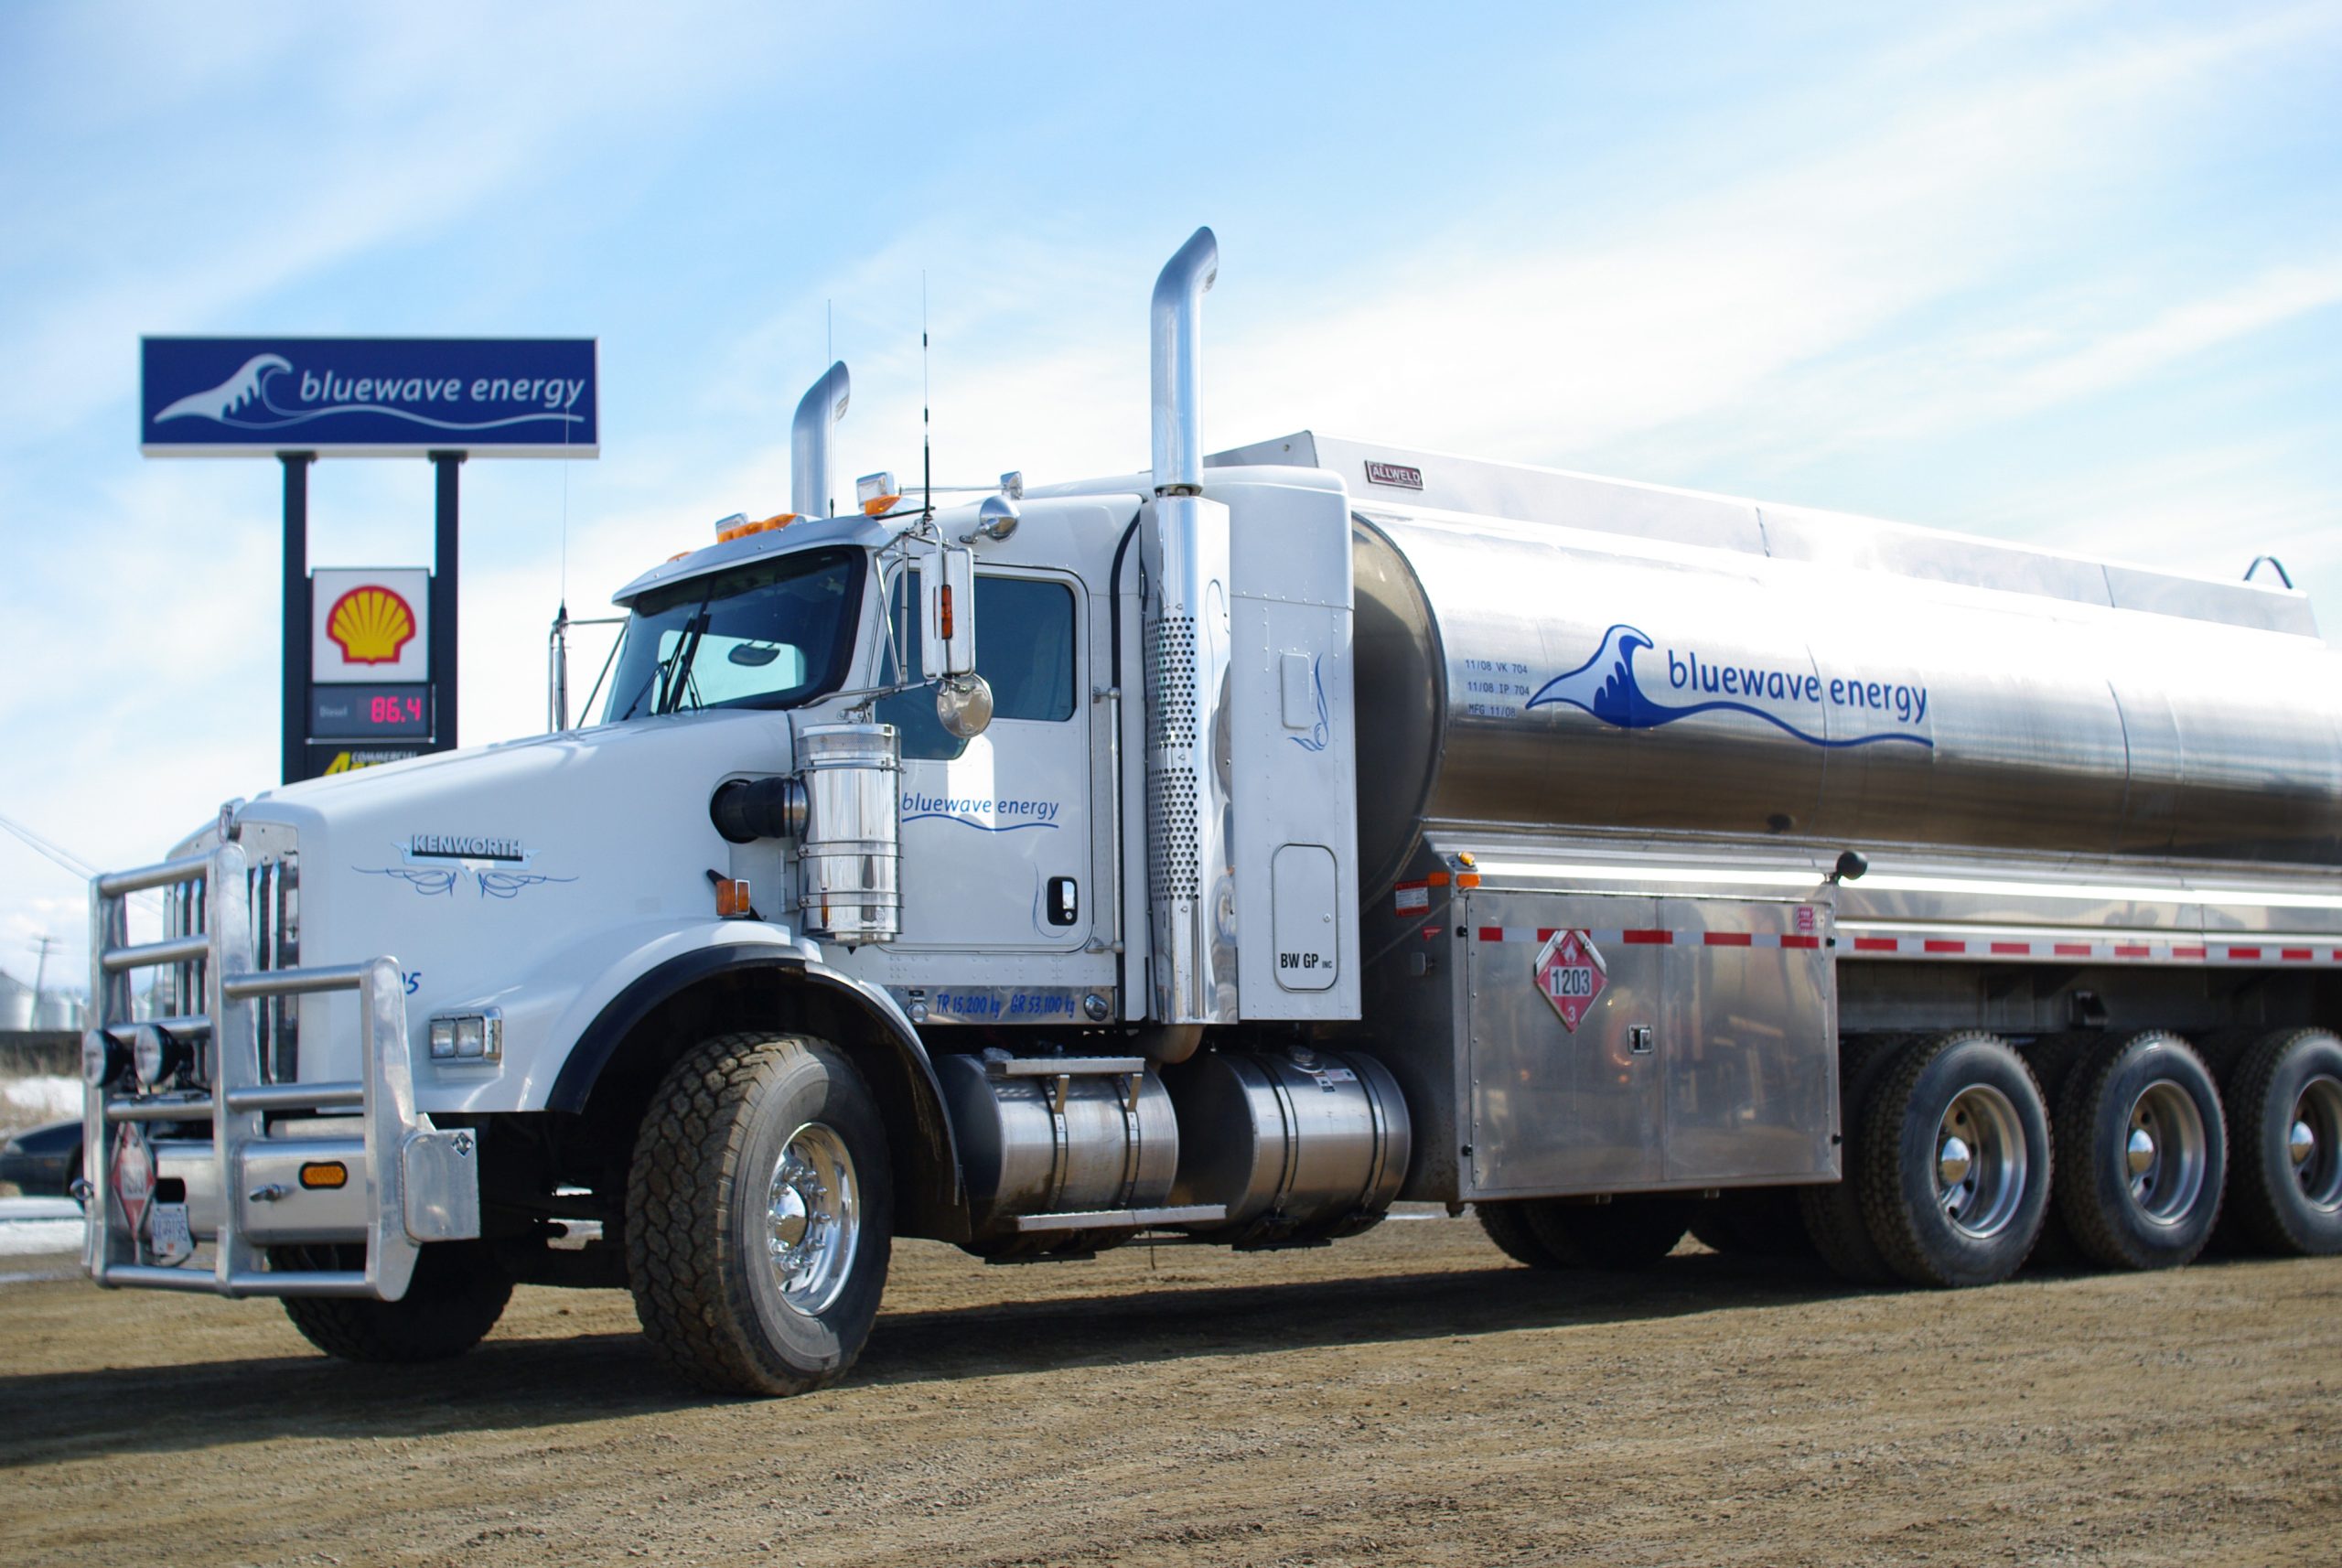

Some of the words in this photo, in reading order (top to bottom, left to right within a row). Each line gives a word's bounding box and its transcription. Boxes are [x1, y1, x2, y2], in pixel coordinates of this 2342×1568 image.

[300, 370, 461, 402] bluewave
[470, 378, 586, 409] energy
[1372, 466, 1421, 483] ALLWELD
[1466, 659, 1492, 671] 11/08
[1496, 661, 1508, 673] VK
[1512, 663, 1528, 674] 704
[1468, 682, 1494, 693] 11/08
[1499, 683, 1509, 693] IP
[1515, 685, 1530, 695] 704
[1668, 650, 1821, 703] bluewave
[1830, 678, 1927, 725] energy
[371, 696, 422, 724] 86.4
[1468, 703, 1485, 714] MFG
[1490, 706, 1516, 717] 11/08
[902, 792, 992, 813] bluewave
[997, 800, 1059, 821] energy
[413, 834, 522, 857] KENWORTH
[1281, 953, 1300, 969] BW
[1304, 953, 1318, 969] GP
[1322, 961, 1332, 969] INC
[1552, 969, 1591, 994] 1203
[937, 993, 951, 1014] TR
[953, 994, 988, 1016] 15,200
[991, 994, 1001, 1018] kg
[1011, 993, 1026, 1014] GR
[1029, 994, 1062, 1016] 53,100
[1065, 994, 1075, 1018] kg
[1568, 1005, 1576, 1022] 3
